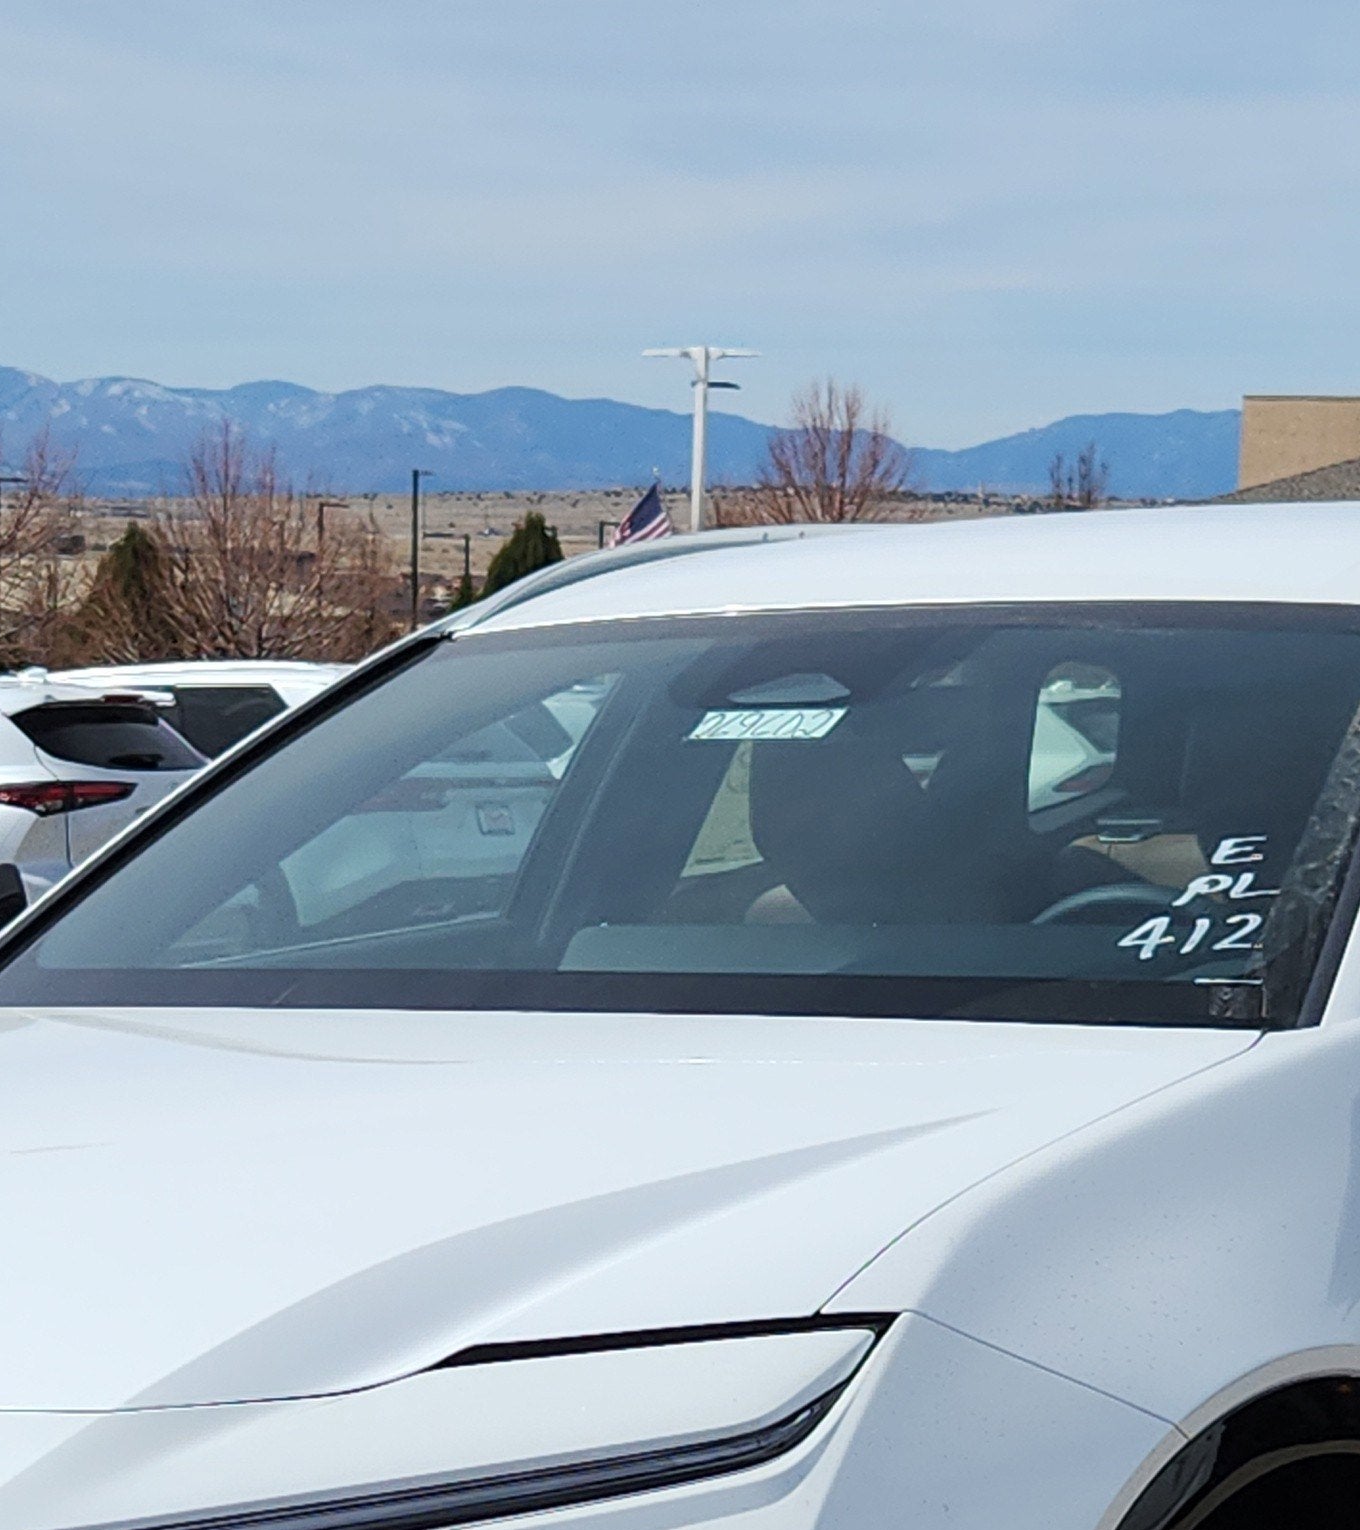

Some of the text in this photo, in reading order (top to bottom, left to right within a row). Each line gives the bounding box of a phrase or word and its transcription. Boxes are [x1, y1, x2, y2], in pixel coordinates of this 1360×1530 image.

[1210, 834, 1268, 865] E
[1171, 872, 1282, 907] PL
[1116, 912, 1265, 961] 412
